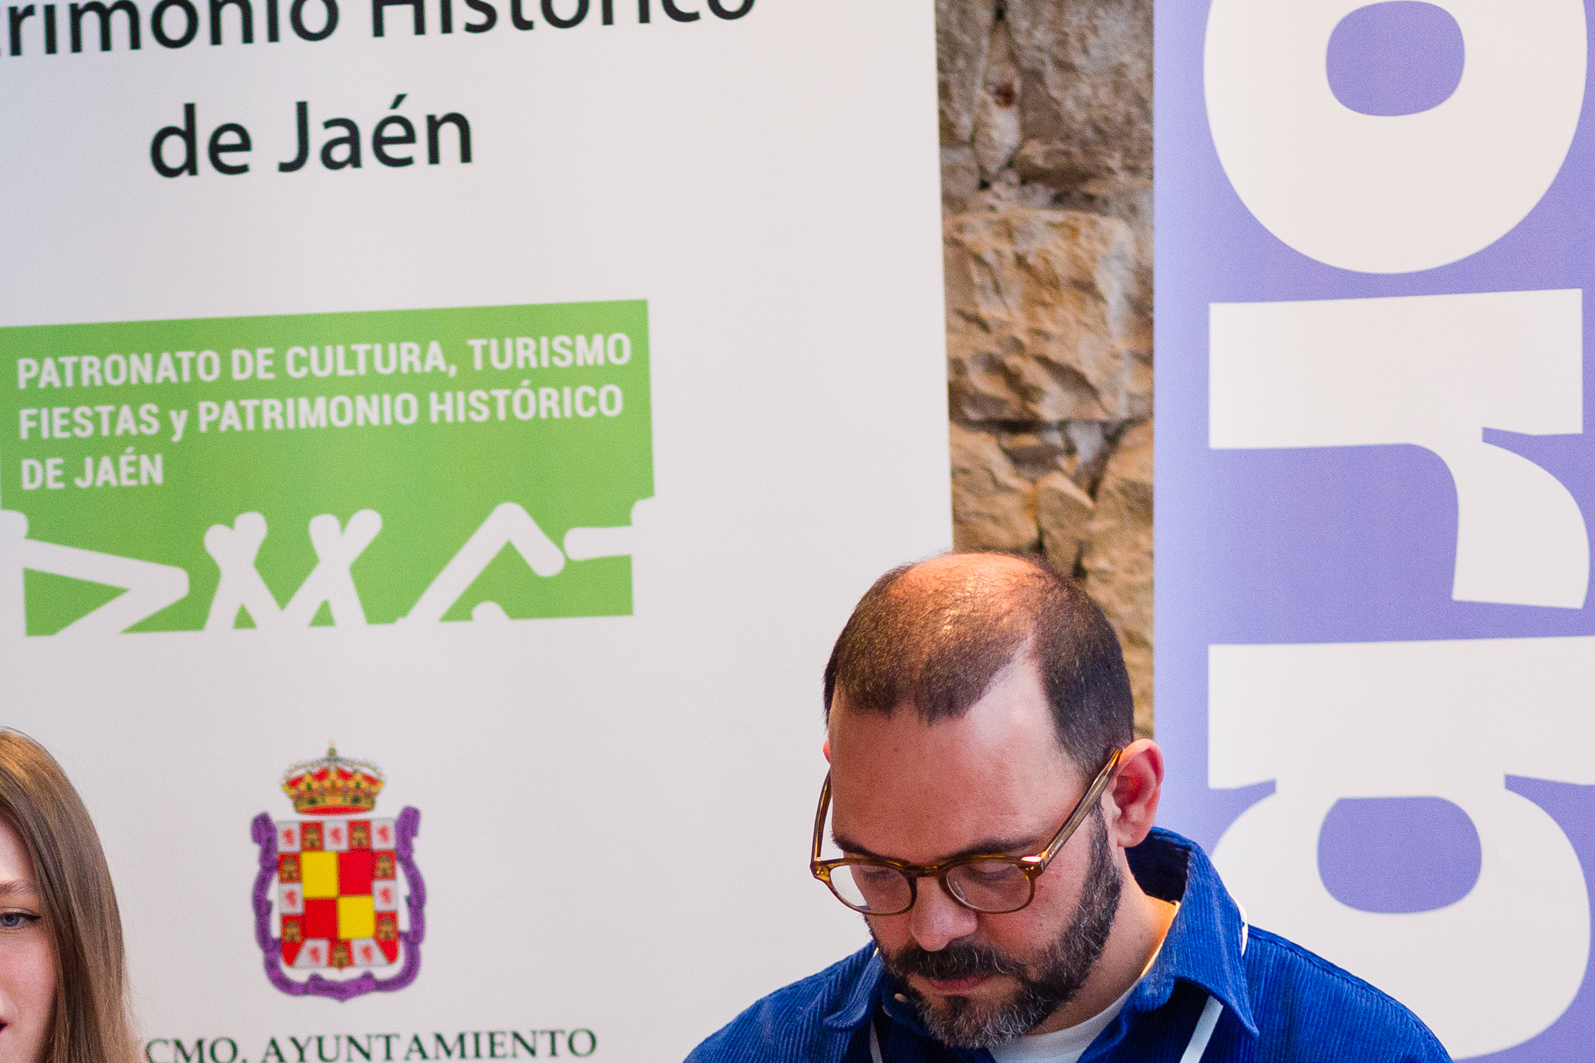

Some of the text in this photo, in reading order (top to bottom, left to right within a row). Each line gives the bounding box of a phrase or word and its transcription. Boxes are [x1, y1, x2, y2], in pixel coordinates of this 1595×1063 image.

[150, 93, 473, 178] de Jaén
[17, 332, 632, 389] PATRONATO DE CULTURA, TURISMO
[19, 379, 624, 442] FIESTAS y PATRIMONIO HISTÓRICO
[21, 446, 164, 490] DE JAÉN
